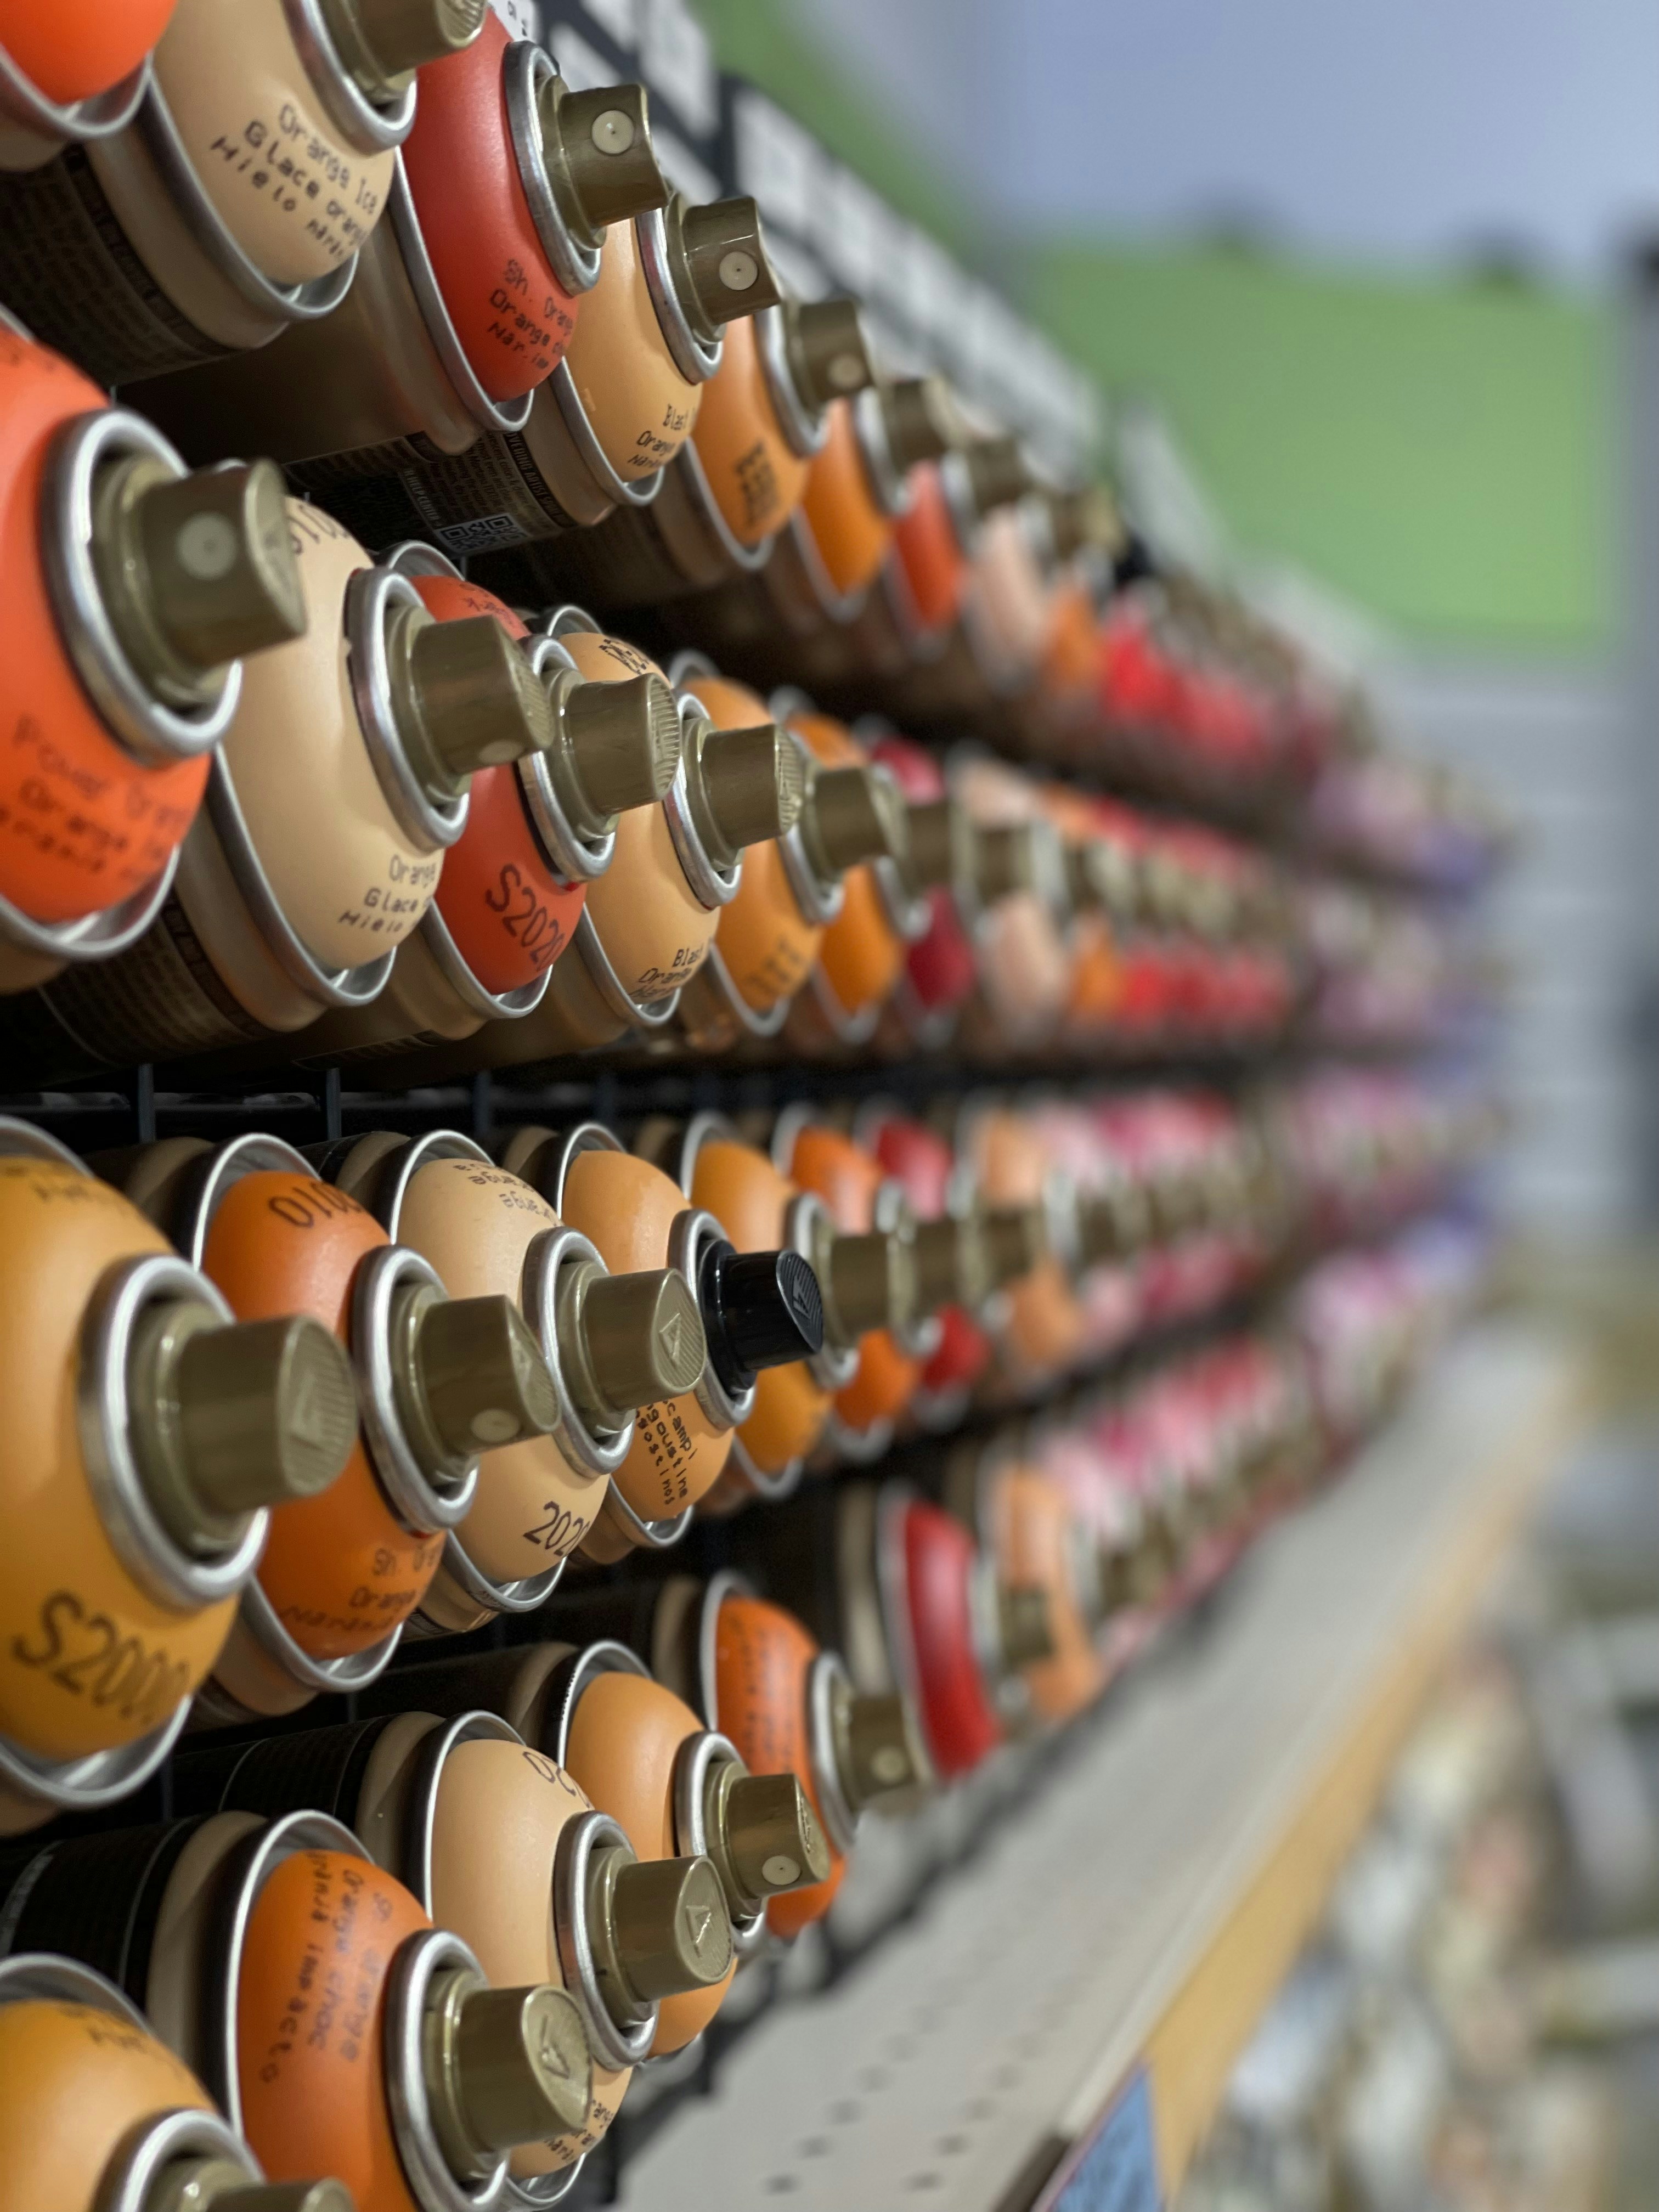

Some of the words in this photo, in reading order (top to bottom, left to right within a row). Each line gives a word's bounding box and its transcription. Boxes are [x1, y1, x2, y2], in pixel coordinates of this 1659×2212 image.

[210, 136, 297, 213] Hielo
[243, 119, 320, 199] Glace
[279, 103, 351, 189] Orange
[489, 287, 551, 347] Orange
